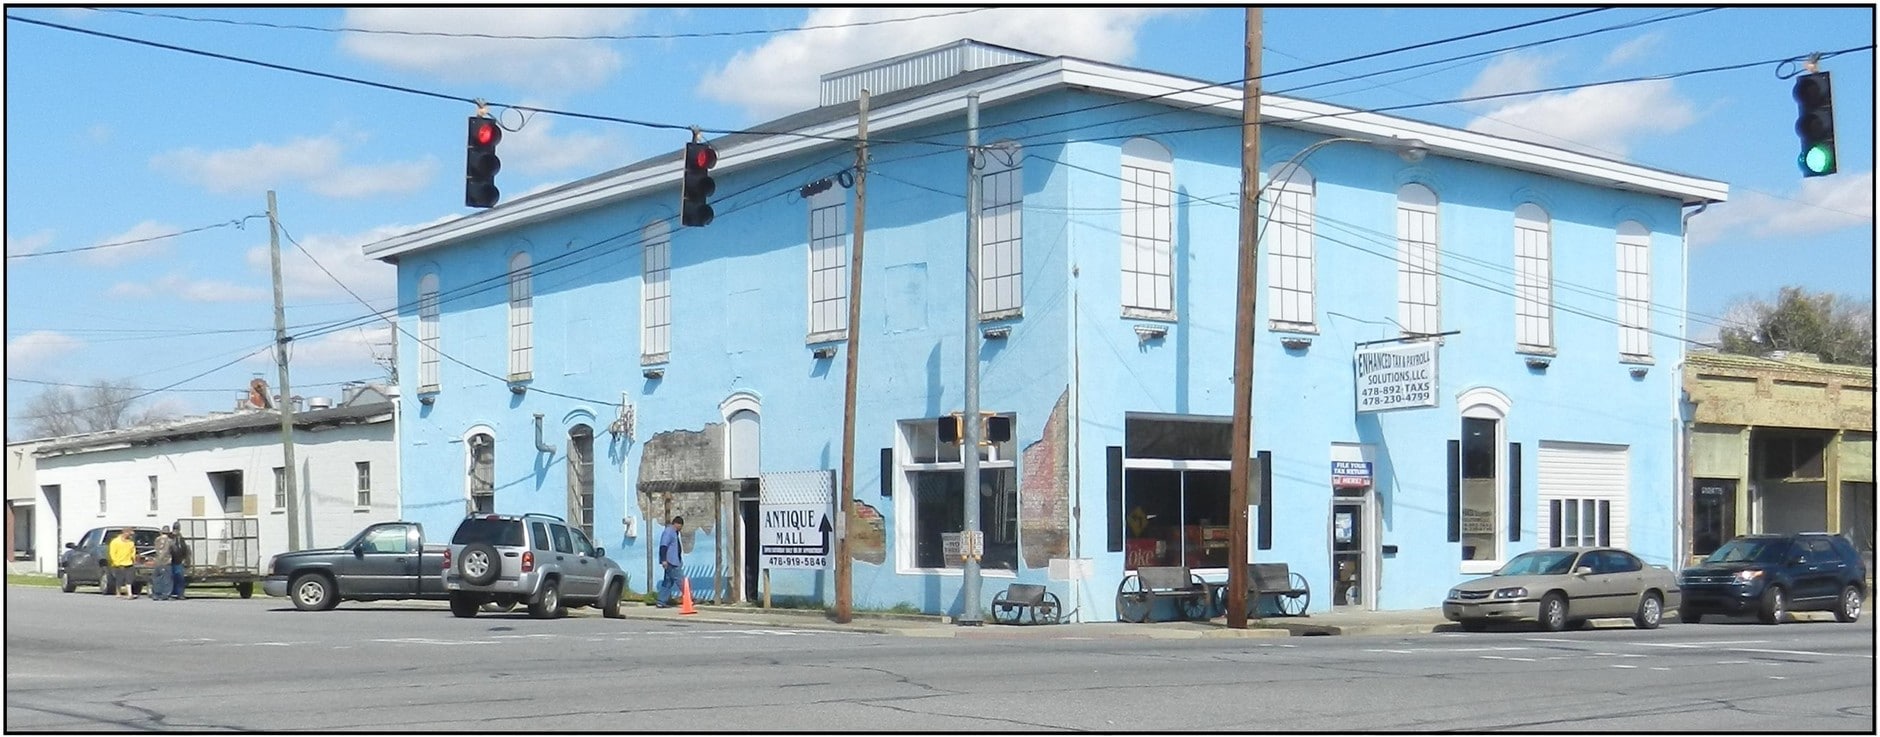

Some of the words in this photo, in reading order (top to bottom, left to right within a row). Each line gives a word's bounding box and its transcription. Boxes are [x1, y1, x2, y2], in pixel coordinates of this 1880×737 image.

[1358, 352, 1391, 378] ENHANCED
[1362, 392, 1430, 405] 478-230-4799
[765, 510, 815, 530] ANTIQUE
[776, 532, 805, 545] MALL
